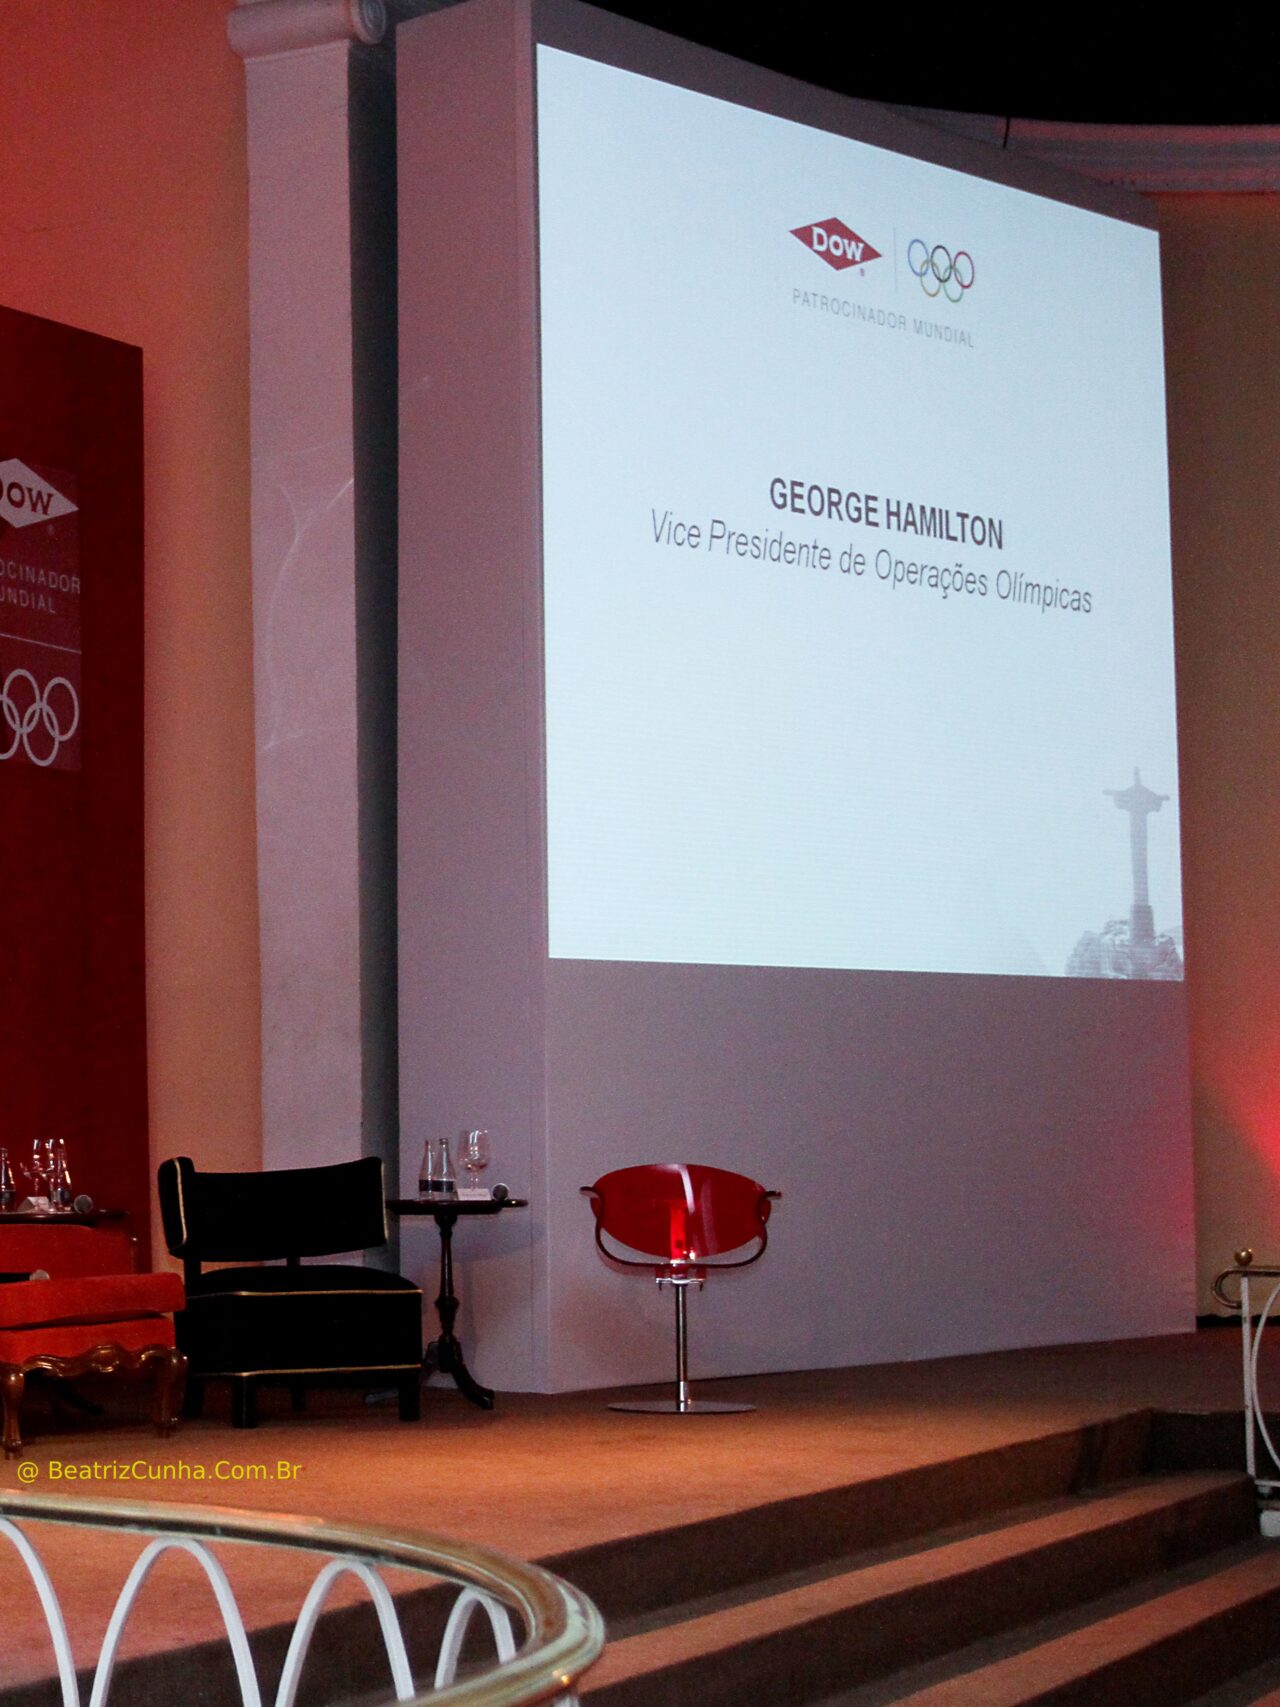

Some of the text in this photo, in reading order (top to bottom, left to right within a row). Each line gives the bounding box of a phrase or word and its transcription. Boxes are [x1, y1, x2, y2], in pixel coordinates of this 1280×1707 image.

[793, 288, 975, 348] PATROCINADOR MUNDIAL
[769, 477, 1004, 550] GEORGE HAMILTON
[651, 507, 1093, 614] Vice Presidente de Operações Olímpicas
